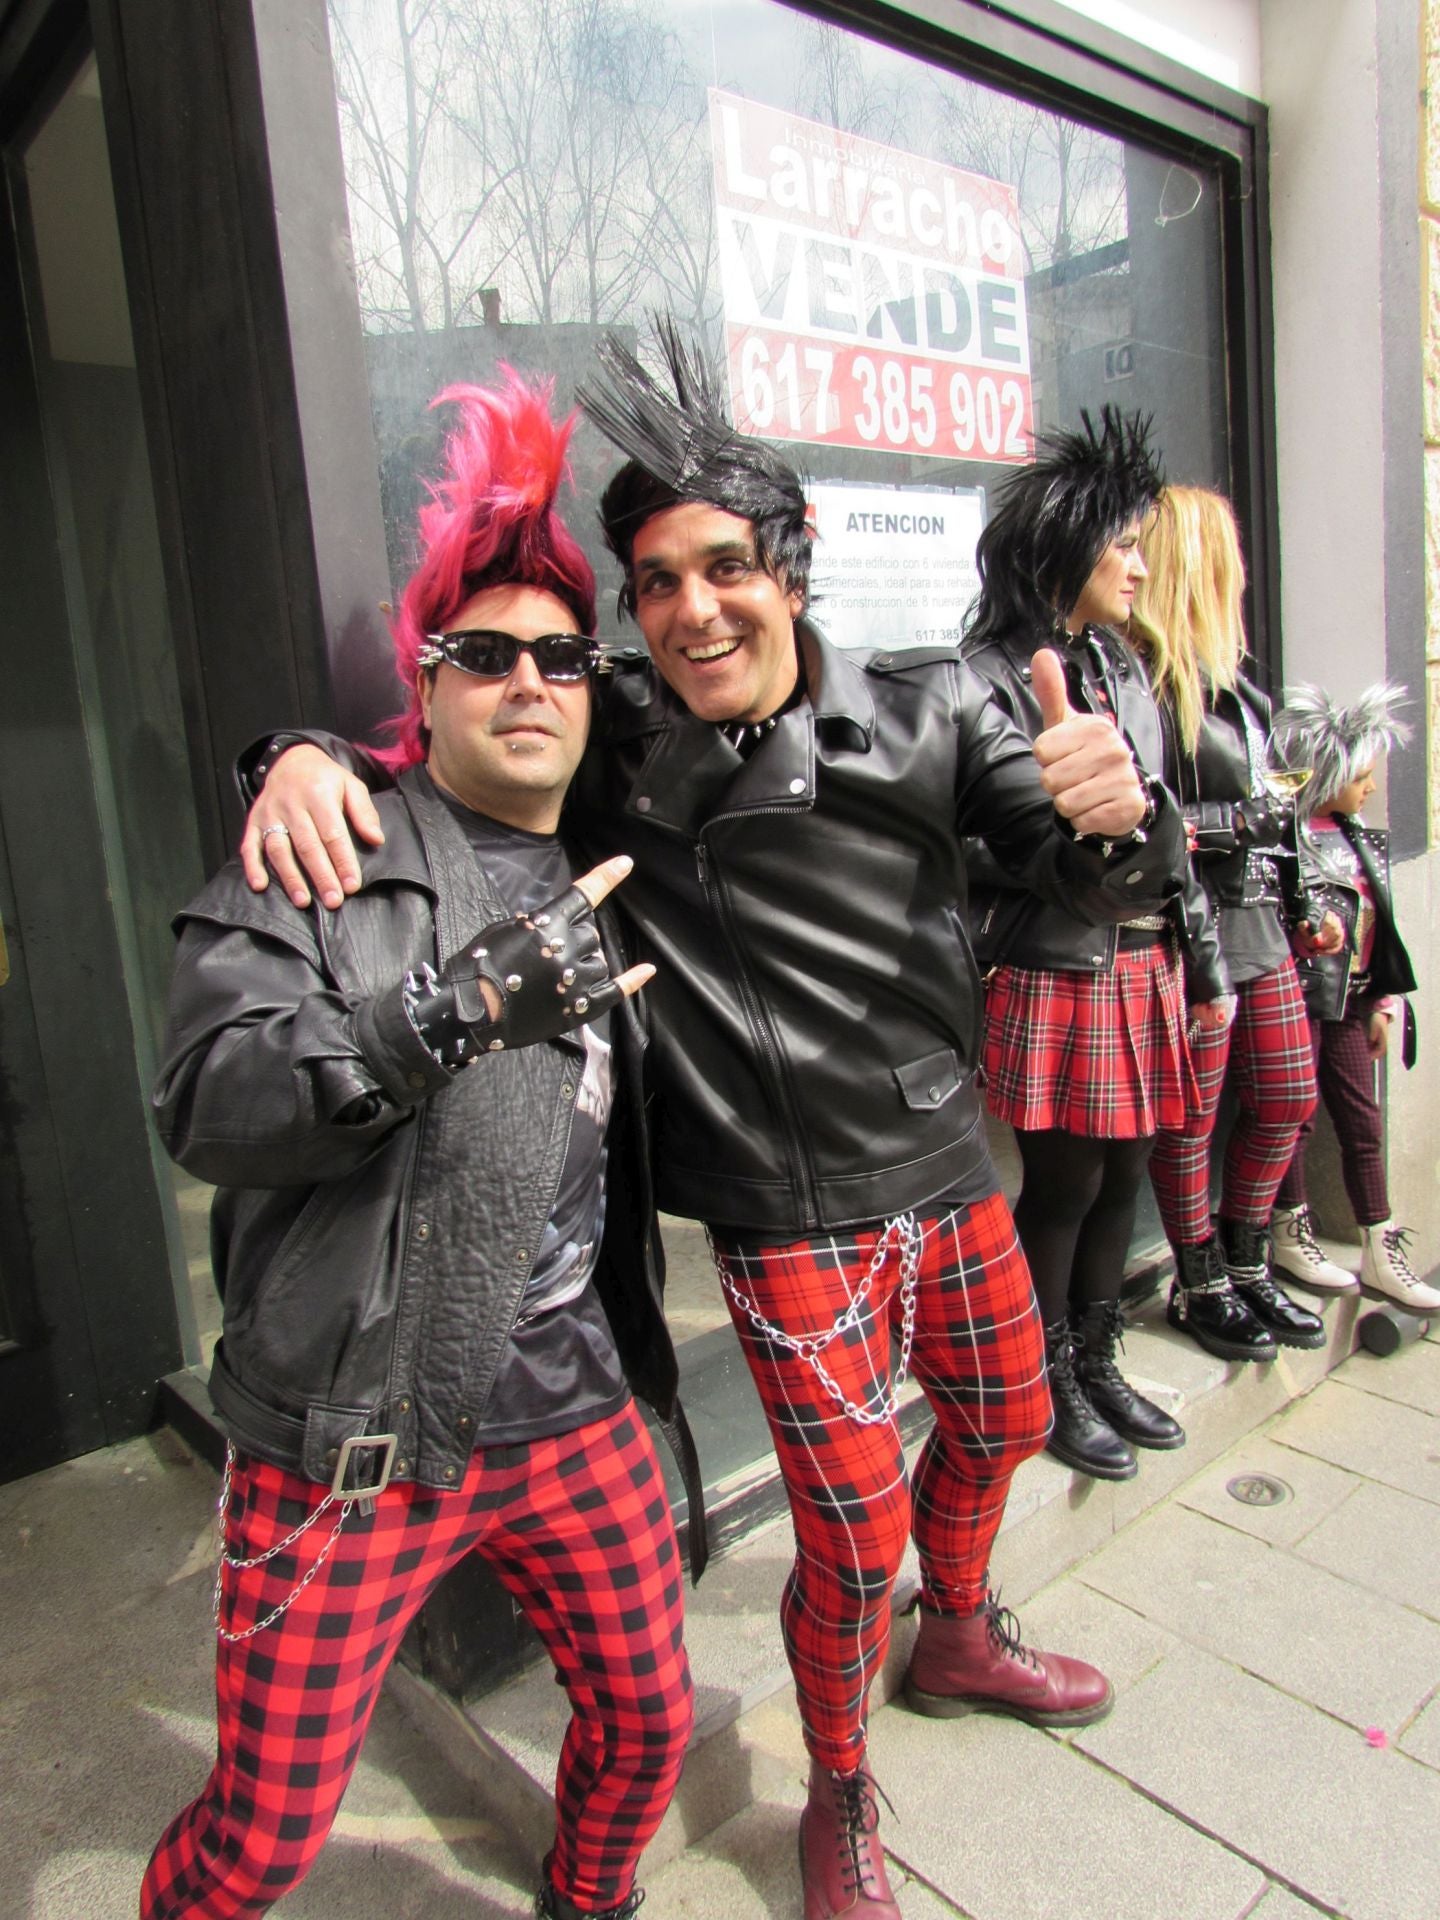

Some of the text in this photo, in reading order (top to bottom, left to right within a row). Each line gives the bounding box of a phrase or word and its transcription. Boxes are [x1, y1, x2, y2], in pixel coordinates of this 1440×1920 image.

[720, 105, 1015, 264] Larracho
[731, 218, 1022, 364] VENDE
[741, 337, 1028, 457] 617 385 902
[846, 512, 945, 535] ATENCION
[811, 555, 838, 568] ende
[841, 556, 863, 568] este
[865, 555, 900, 569] edificio
[903, 558, 920, 569] con
[885, 575, 907, 589] ideal
[910, 579, 931, 590] para
[933, 579, 945, 589] su
[906, 596, 918, 608] de
[932, 597, 966, 608] nuevas
[915, 628, 960, 642] 617 385
